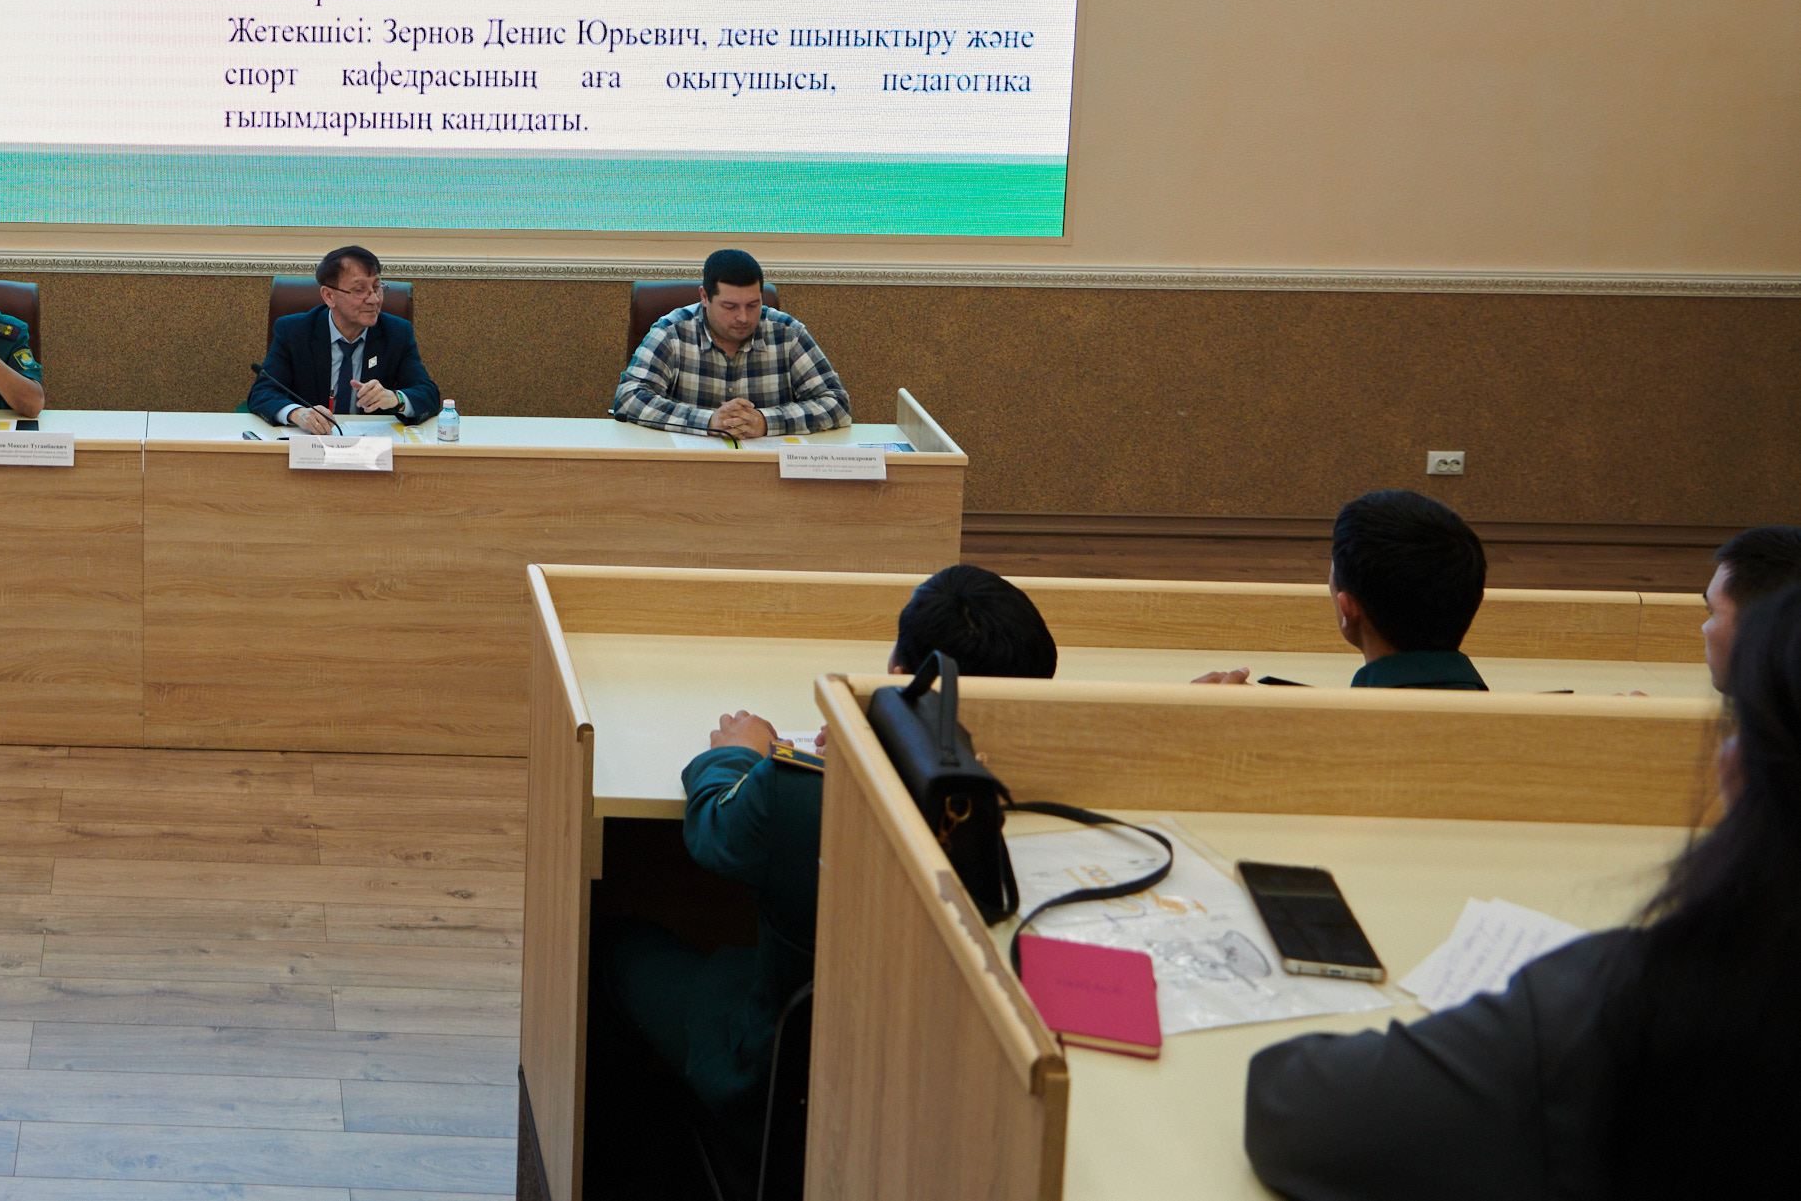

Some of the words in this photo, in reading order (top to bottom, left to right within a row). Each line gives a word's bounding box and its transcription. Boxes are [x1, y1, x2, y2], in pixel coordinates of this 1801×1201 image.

[228, 17, 372, 45] Жетекшісі:
[382, 18, 475, 51] Зернов
[483, 18, 566, 48] Денис
[577, 18, 708, 53] Юрьевич,
[717, 28, 780, 49] дене
[966, 29, 1034, 49] және
[224, 67, 299, 95] спорт
[342, 61, 538, 95] кафедрасының
[581, 69, 621, 89] аға
[665, 71, 837, 97] оқытушысы,
[882, 72, 1032, 94] педагогика
[225, 110, 433, 136] ғылымдарының
[442, 111, 589, 133] кандидаты.
